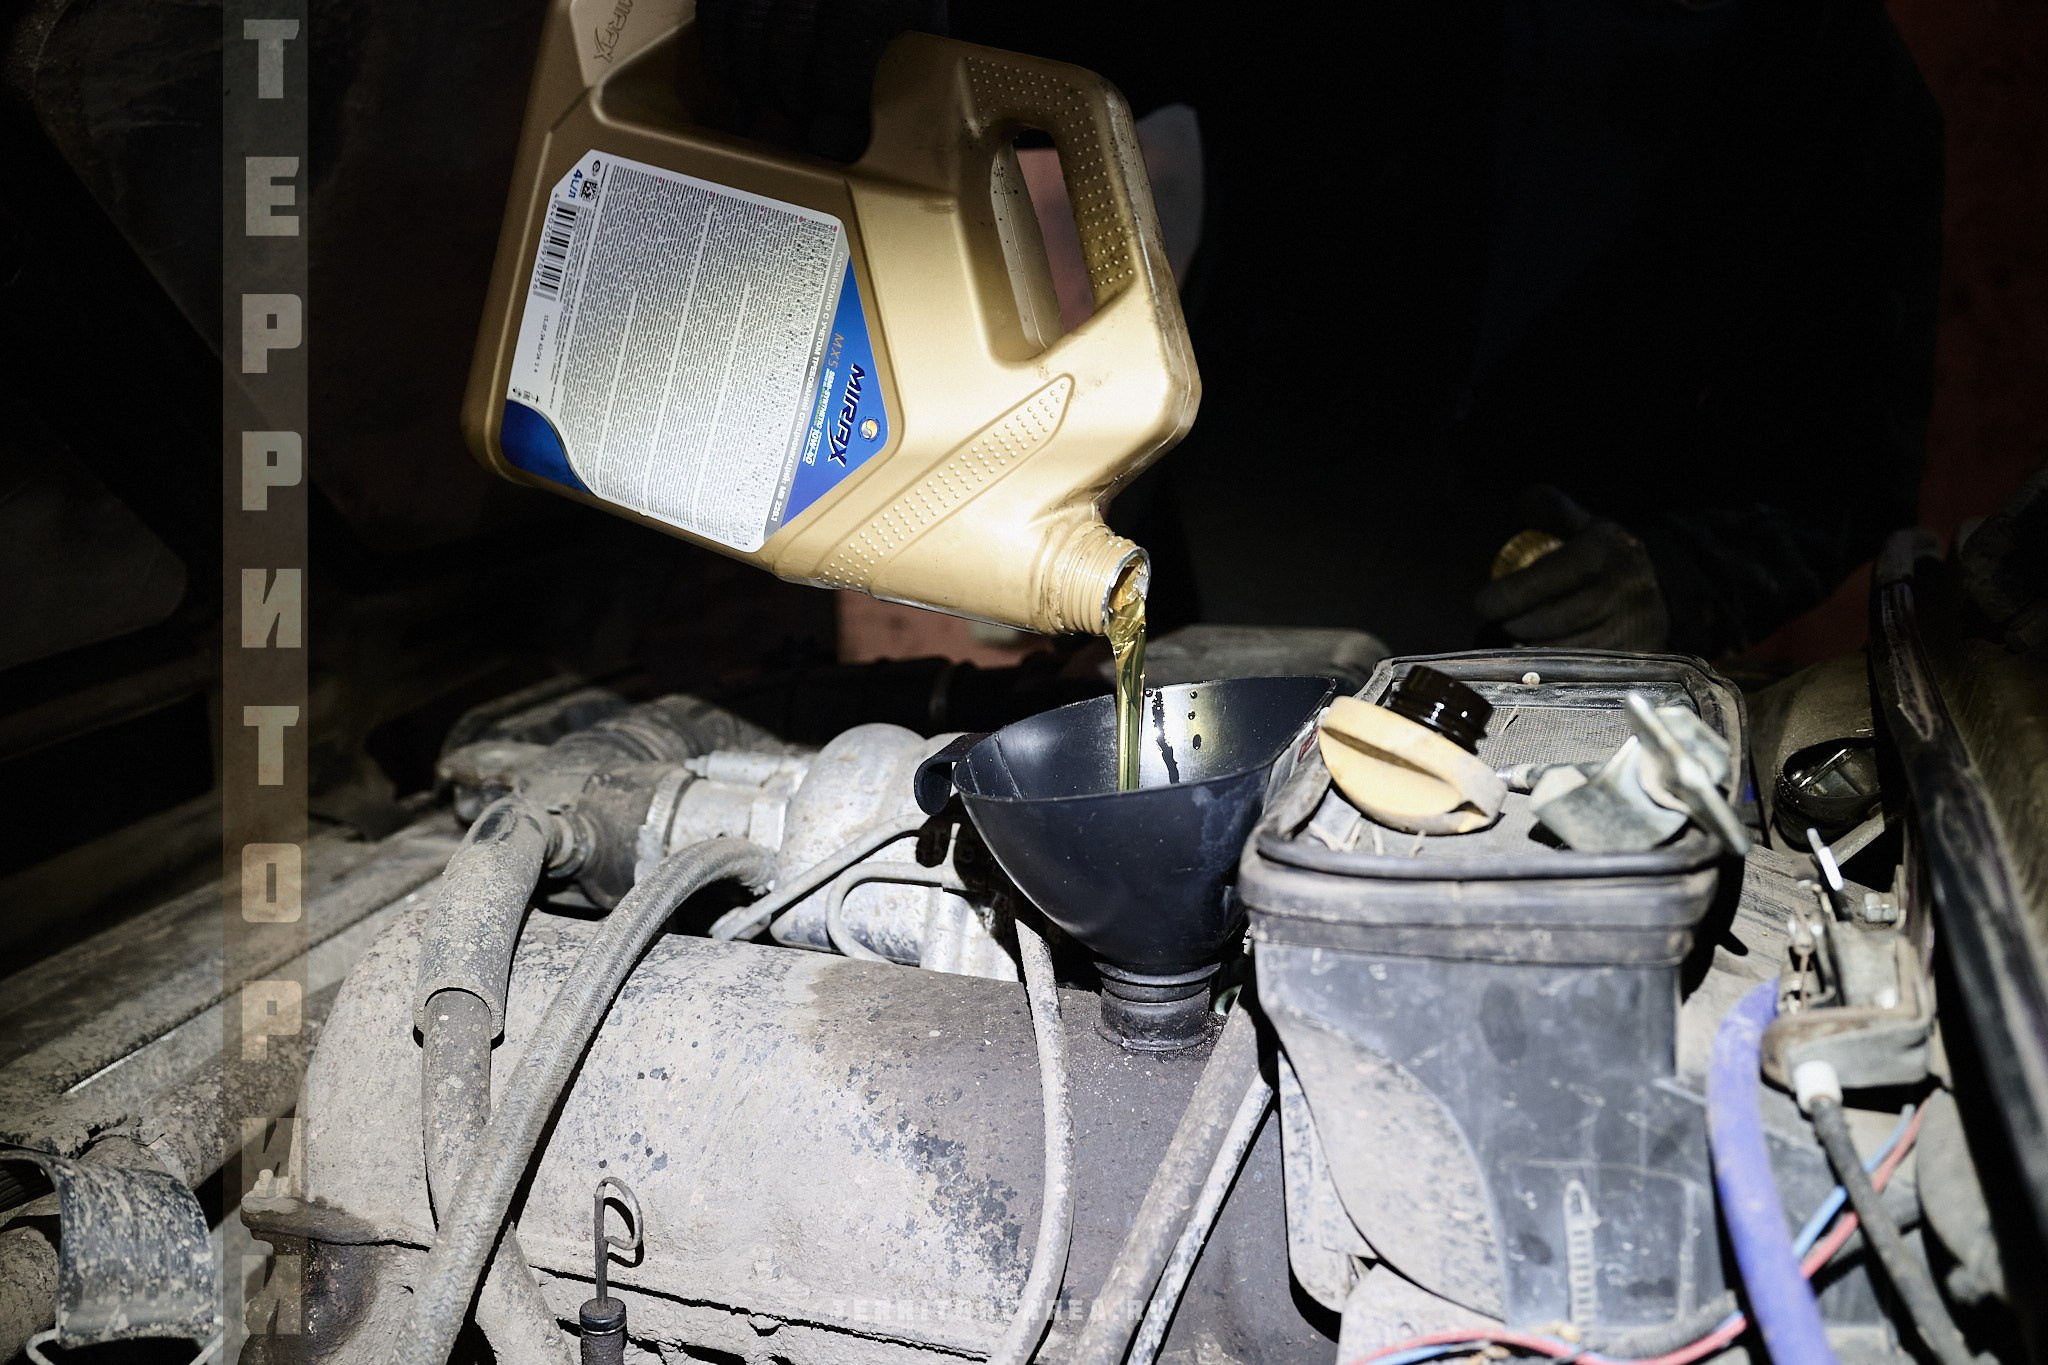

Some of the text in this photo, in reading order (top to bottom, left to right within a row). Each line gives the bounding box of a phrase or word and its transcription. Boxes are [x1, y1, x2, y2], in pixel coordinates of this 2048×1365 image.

[594, 0, 633, 63] IRAX
[826, 251, 844, 311] РАЗРАБОТАНО
[814, 321, 828, 356] УЧЕТОМ
[823, 312, 829, 320] С
[827, 332, 845, 369] MX5
[801, 356, 820, 411] ТРЕБОВАНИЙ
[819, 371, 836, 430] SEMI-SYNTHETIC
[827, 362, 866, 467] MIRAX
[783, 411, 806, 485] СПЕЦИФИКАЦИЙ:
[805, 429, 820, 465] 10W-40
[771, 500, 782, 522] 229.1
